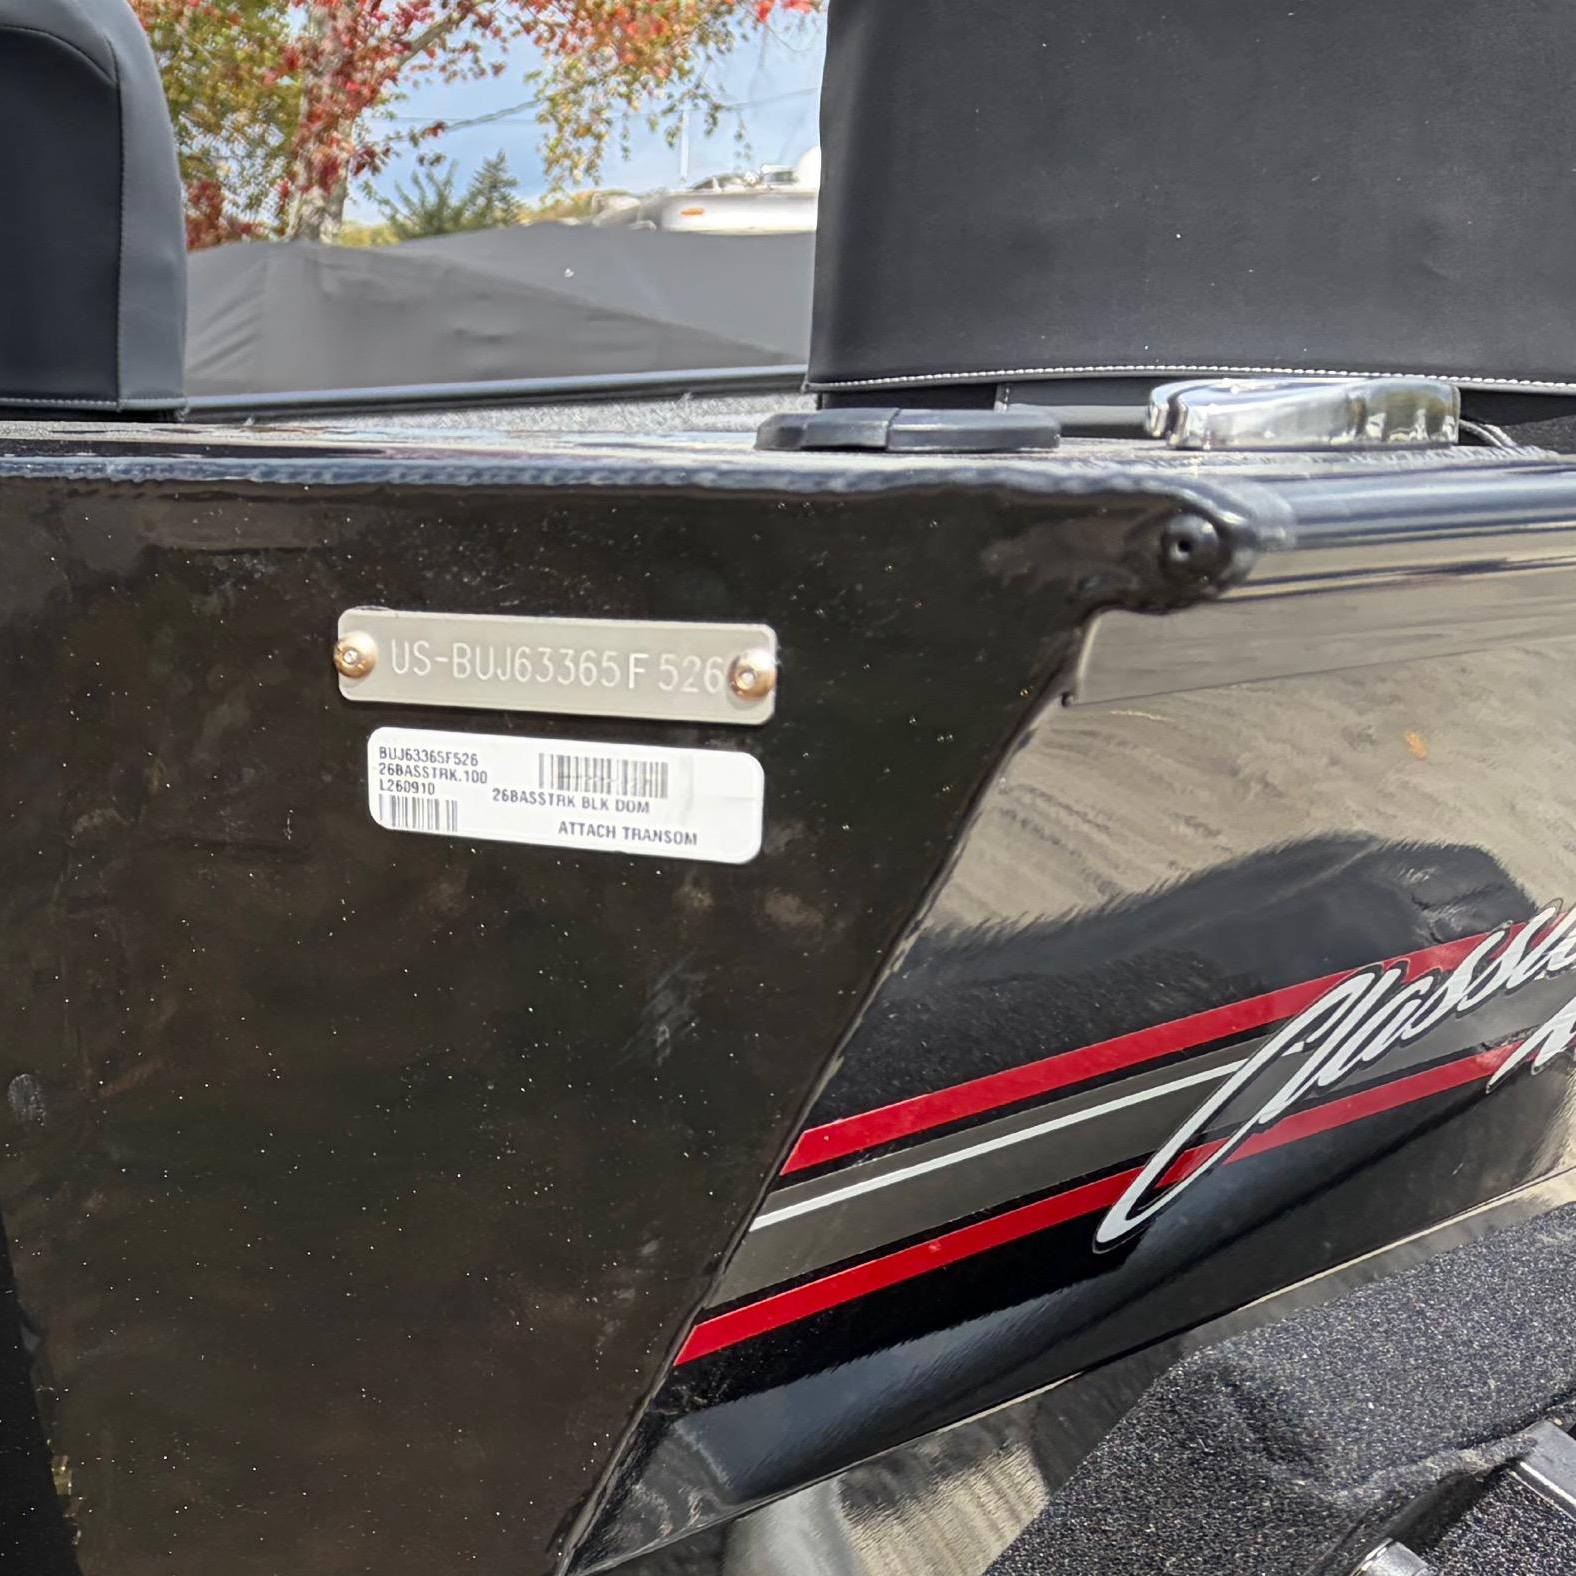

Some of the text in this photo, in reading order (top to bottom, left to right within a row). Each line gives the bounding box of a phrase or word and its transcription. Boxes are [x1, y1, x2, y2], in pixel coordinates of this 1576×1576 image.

[379, 747, 478, 766] BUJ63365F526
[379, 763, 487, 784] 26BASSTRK.100
[379, 779, 435, 795] L260910
[492, 788, 649, 814] 26BASSTRK BLK DOM
[559, 821, 697, 846] ATTACH TRANSOM
